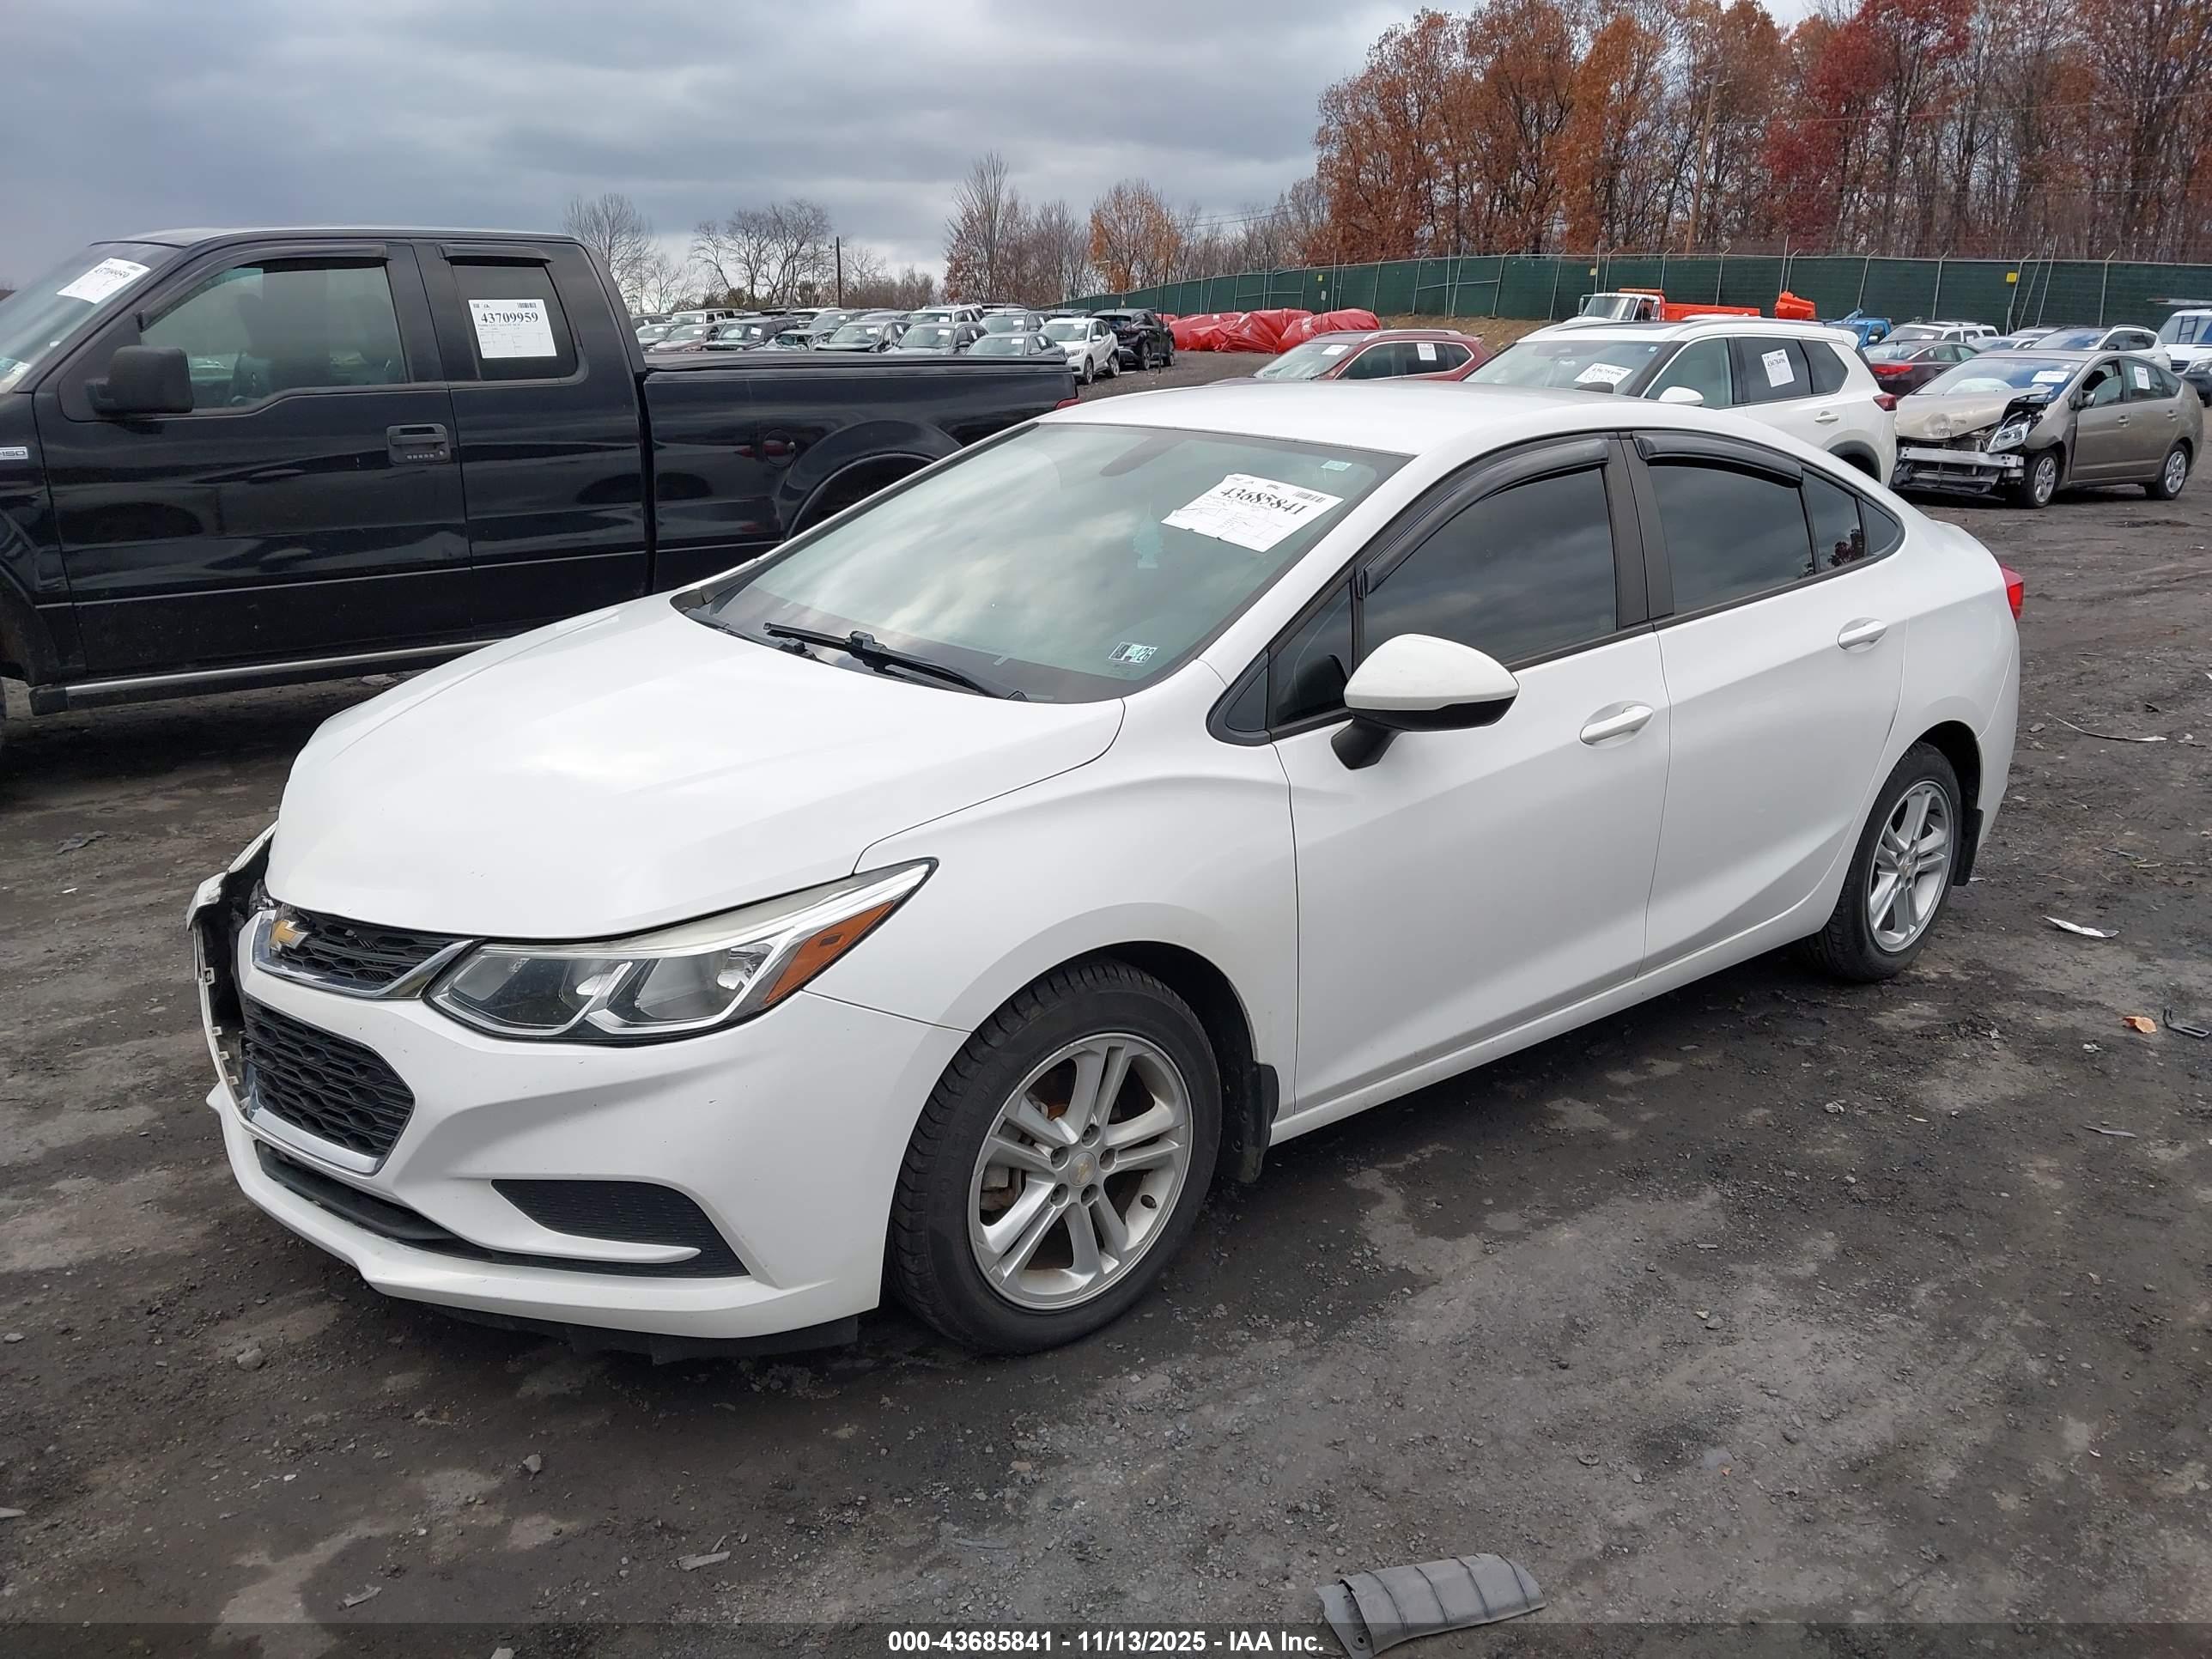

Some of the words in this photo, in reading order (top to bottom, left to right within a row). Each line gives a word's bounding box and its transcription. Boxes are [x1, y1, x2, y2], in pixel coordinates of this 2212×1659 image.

[481, 313, 538, 323] 43709959
[1220, 487, 1308, 515] 43685841
[1136, 647, 1155, 661] 26
